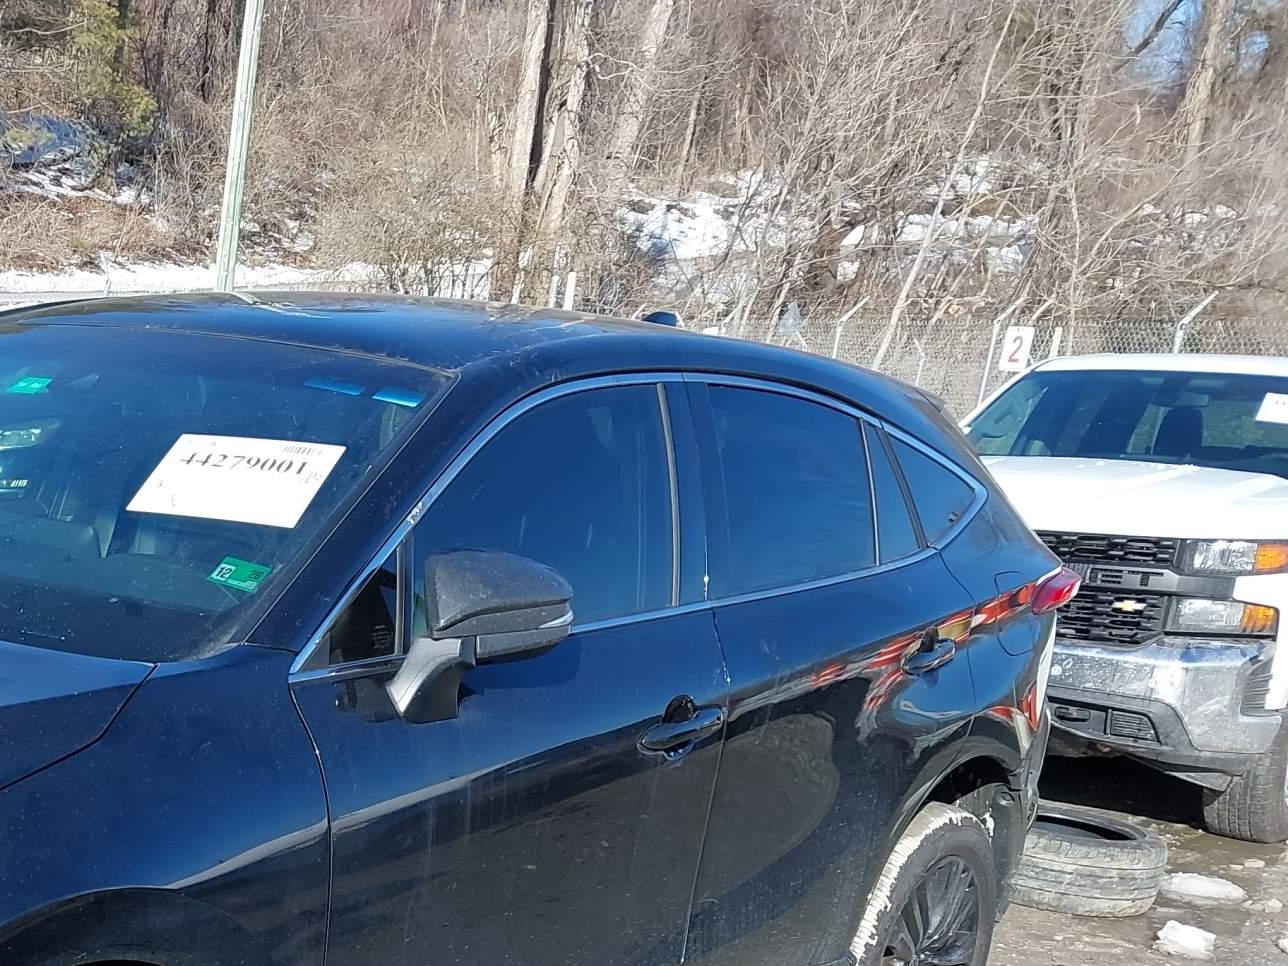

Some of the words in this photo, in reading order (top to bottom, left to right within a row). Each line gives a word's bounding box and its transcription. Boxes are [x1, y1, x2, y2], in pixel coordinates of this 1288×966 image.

[1007, 335, 1024, 363] 2
[180, 451, 309, 475] 44279001
[215, 566, 233, 579] 12
